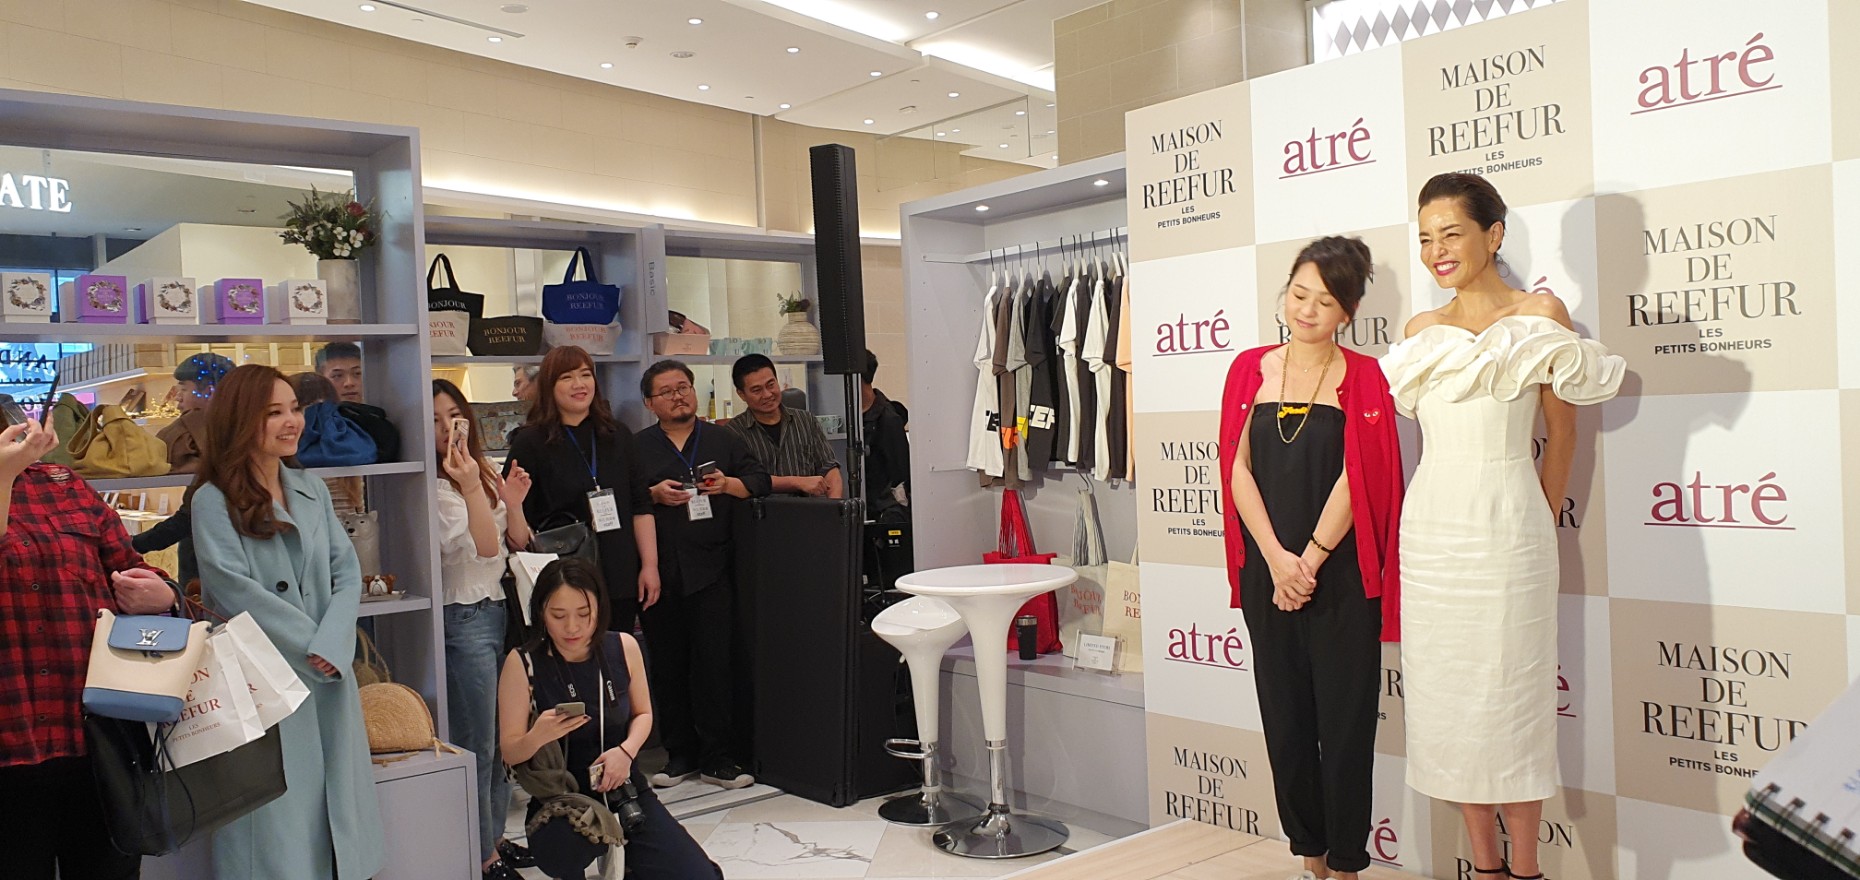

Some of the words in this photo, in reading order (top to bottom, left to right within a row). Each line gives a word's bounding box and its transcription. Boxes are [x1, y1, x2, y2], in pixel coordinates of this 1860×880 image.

[1440, 45, 1546, 91] MAISON
[1637, 32, 1776, 108] atré
[1474, 83, 1512, 113] DE
[1151, 119, 1223, 154] MAISON
[1427, 103, 1566, 157] REEFUR
[1283, 117, 1371, 174] atré
[1485, 151, 1504, 162] LES
[1174, 150, 1200, 174] DE
[1486, 157, 1543, 174] BONHEURS
[1142, 168, 1237, 209] REEFUR
[1157, 218, 1181, 229] PETITS
[1182, 211, 1221, 225] BONHEURS
[1181, 205, 1195, 214] LES
[1643, 214, 1778, 256] MAISON
[1685, 253, 1733, 283] DE
[1626, 280, 1802, 327] REEFUR
[483, 326, 527, 336] BONJOUR
[489, 335, 526, 344] REEFUR
[1156, 309, 1230, 353] atré
[1699, 328, 1724, 338] LES
[1654, 343, 1697, 355] PETITS
[1700, 338, 1773, 352] BONHEURS
[1160, 441, 1220, 461] MAISO
[1185, 465, 1211, 485] DE
[1152, 488, 1225, 516] REEFU
[1651, 471, 1788, 526] atré
[1168, 527, 1191, 536] PETITS
[1192, 518, 1206, 526] LES
[1168, 622, 1244, 667] atré
[1656, 640, 1792, 680] MAISON
[567, 683, 577, 698] EOS
[606, 680, 616, 701] Canon
[1699, 676, 1748, 708] DE
[1173, 746, 1248, 780] MAISON
[1669, 756, 1711, 772] PETITS
[1714, 750, 1739, 762] LES
[1198, 775, 1224, 799] DE
[1164, 791, 1262, 837] REEFUR
